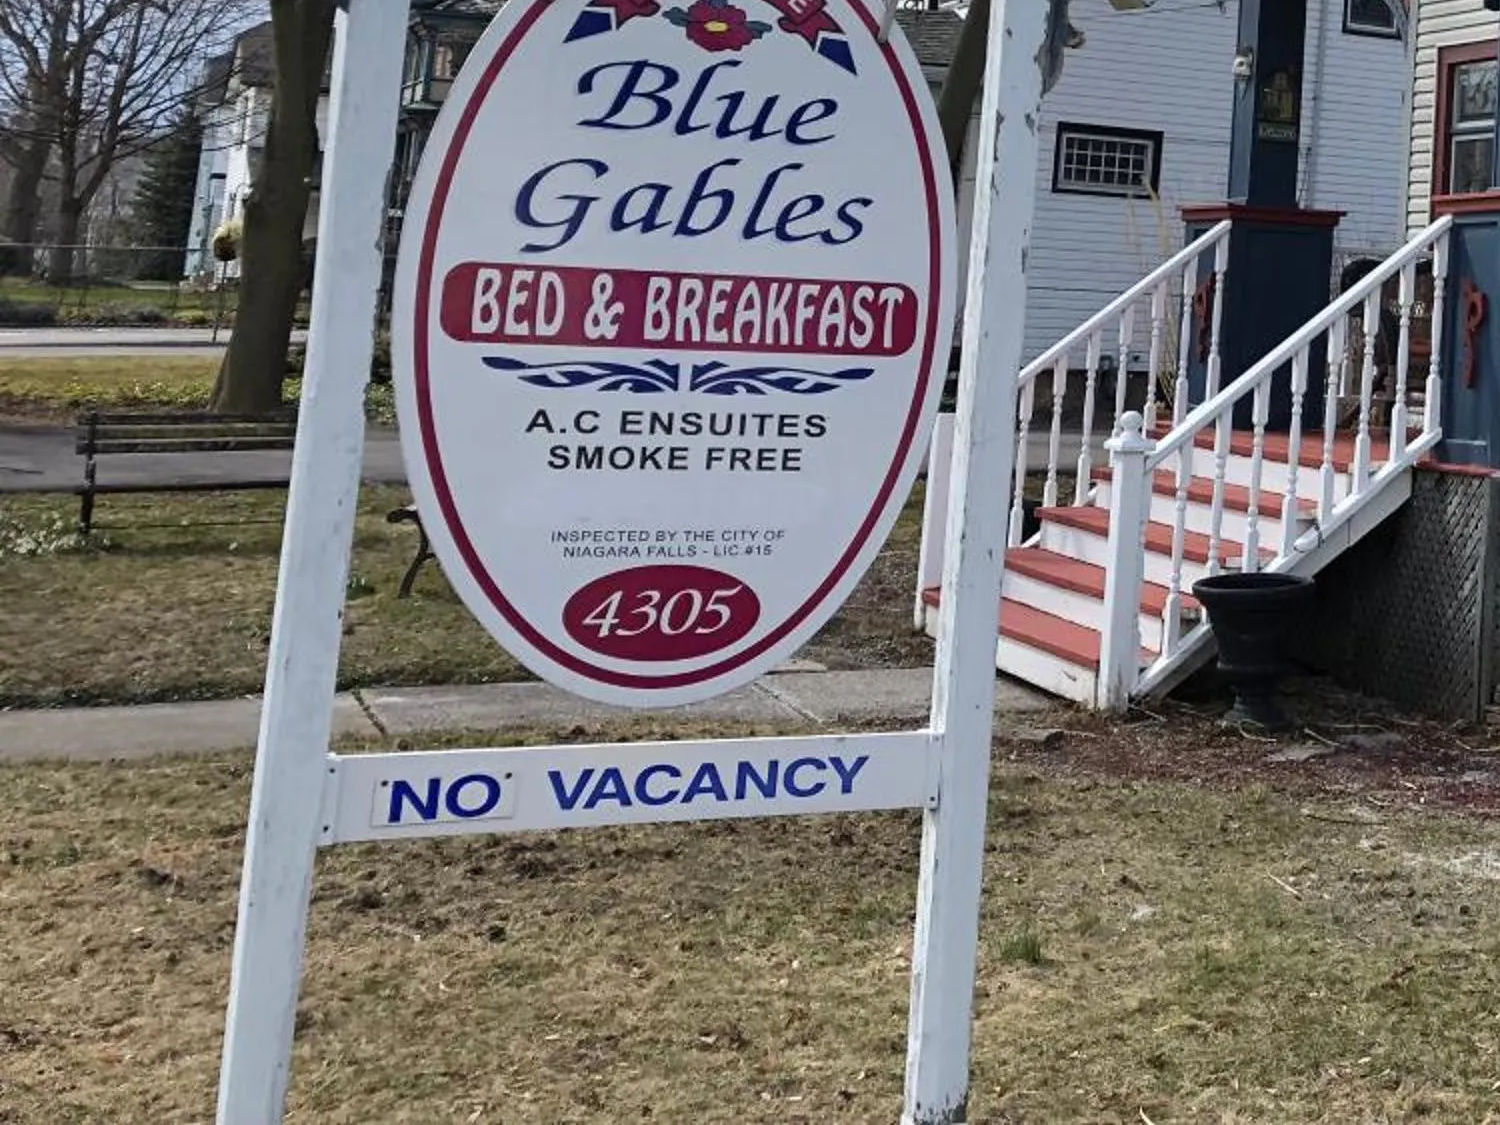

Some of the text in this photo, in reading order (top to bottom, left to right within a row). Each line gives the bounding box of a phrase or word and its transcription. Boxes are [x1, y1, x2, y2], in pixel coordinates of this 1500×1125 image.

[577, 59, 838, 145] Blue
[514, 158, 874, 253] Gables
[471, 268, 904, 349] BED & BREAKFAST
[525, 409, 828, 438] A.C ENSUITES
[547, 446, 803, 471] SMOKE FREE
[551, 530, 786, 543] INSPECTED BY THE CITY OF
[563, 546, 641, 558] NIAGARA
[647, 545, 697, 557] FALLS
[582, 584, 742, 638] 4305
[387, 755, 870, 823] NO VACANCY
